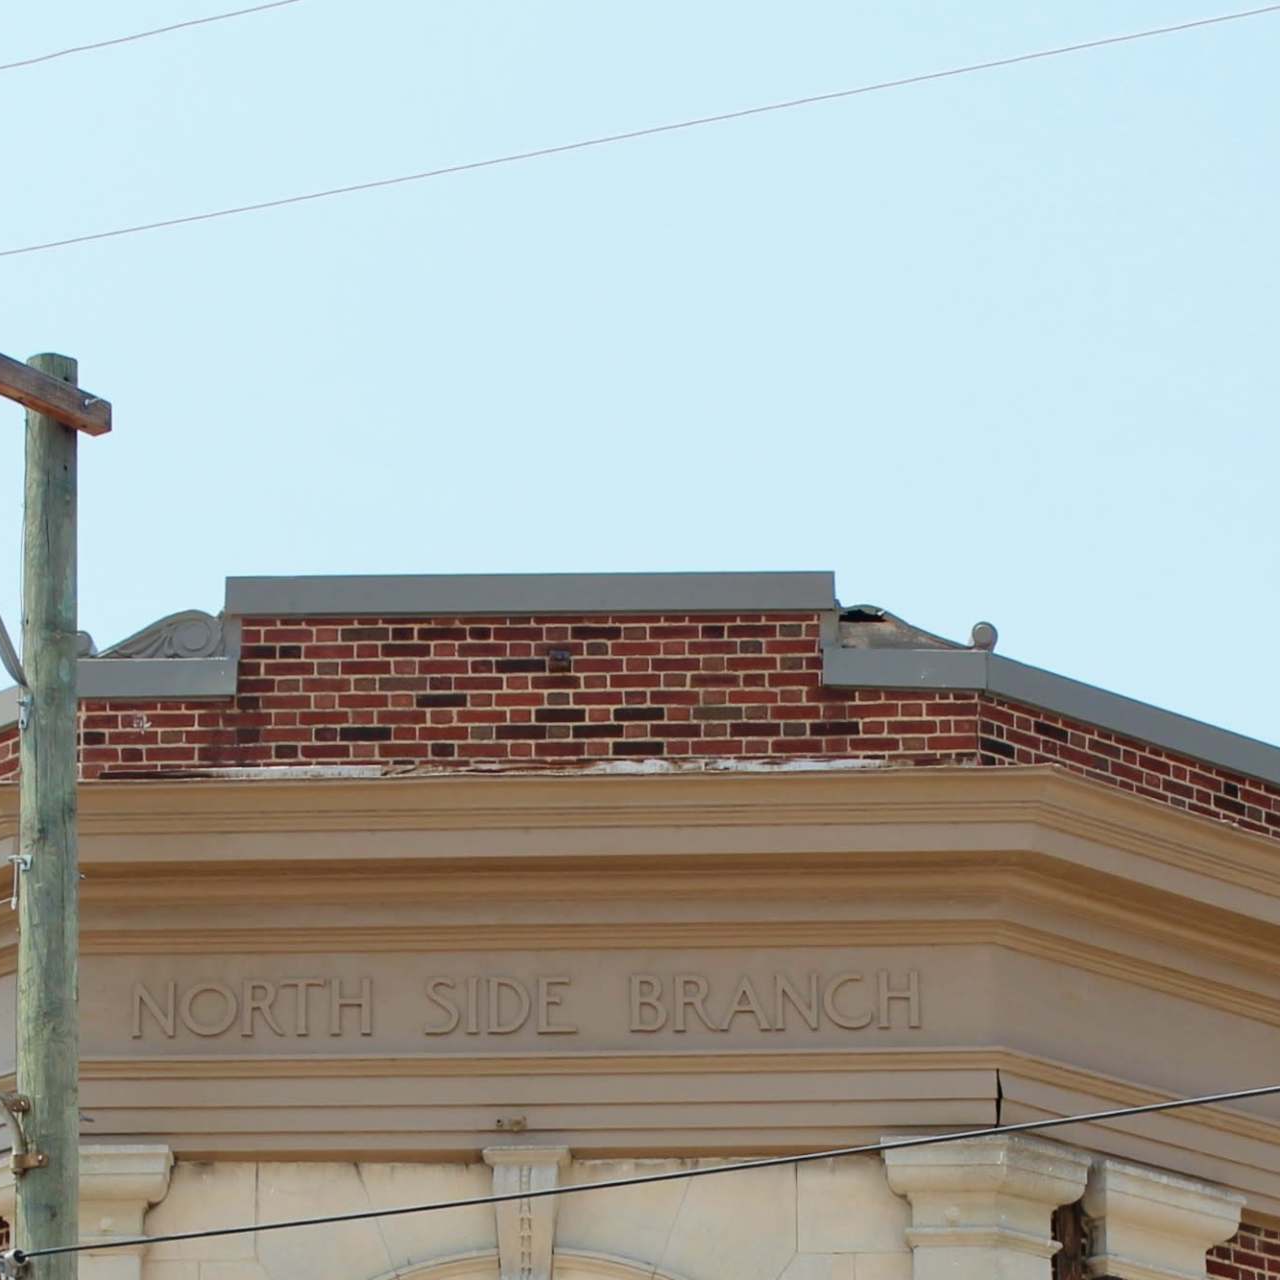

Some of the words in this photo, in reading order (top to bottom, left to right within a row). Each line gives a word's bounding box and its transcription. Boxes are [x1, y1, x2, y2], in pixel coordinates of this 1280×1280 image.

[131, 977, 374, 1039] NORTH
[424, 975, 579, 1036] SIDE
[629, 969, 922, 1033] BRANCH
